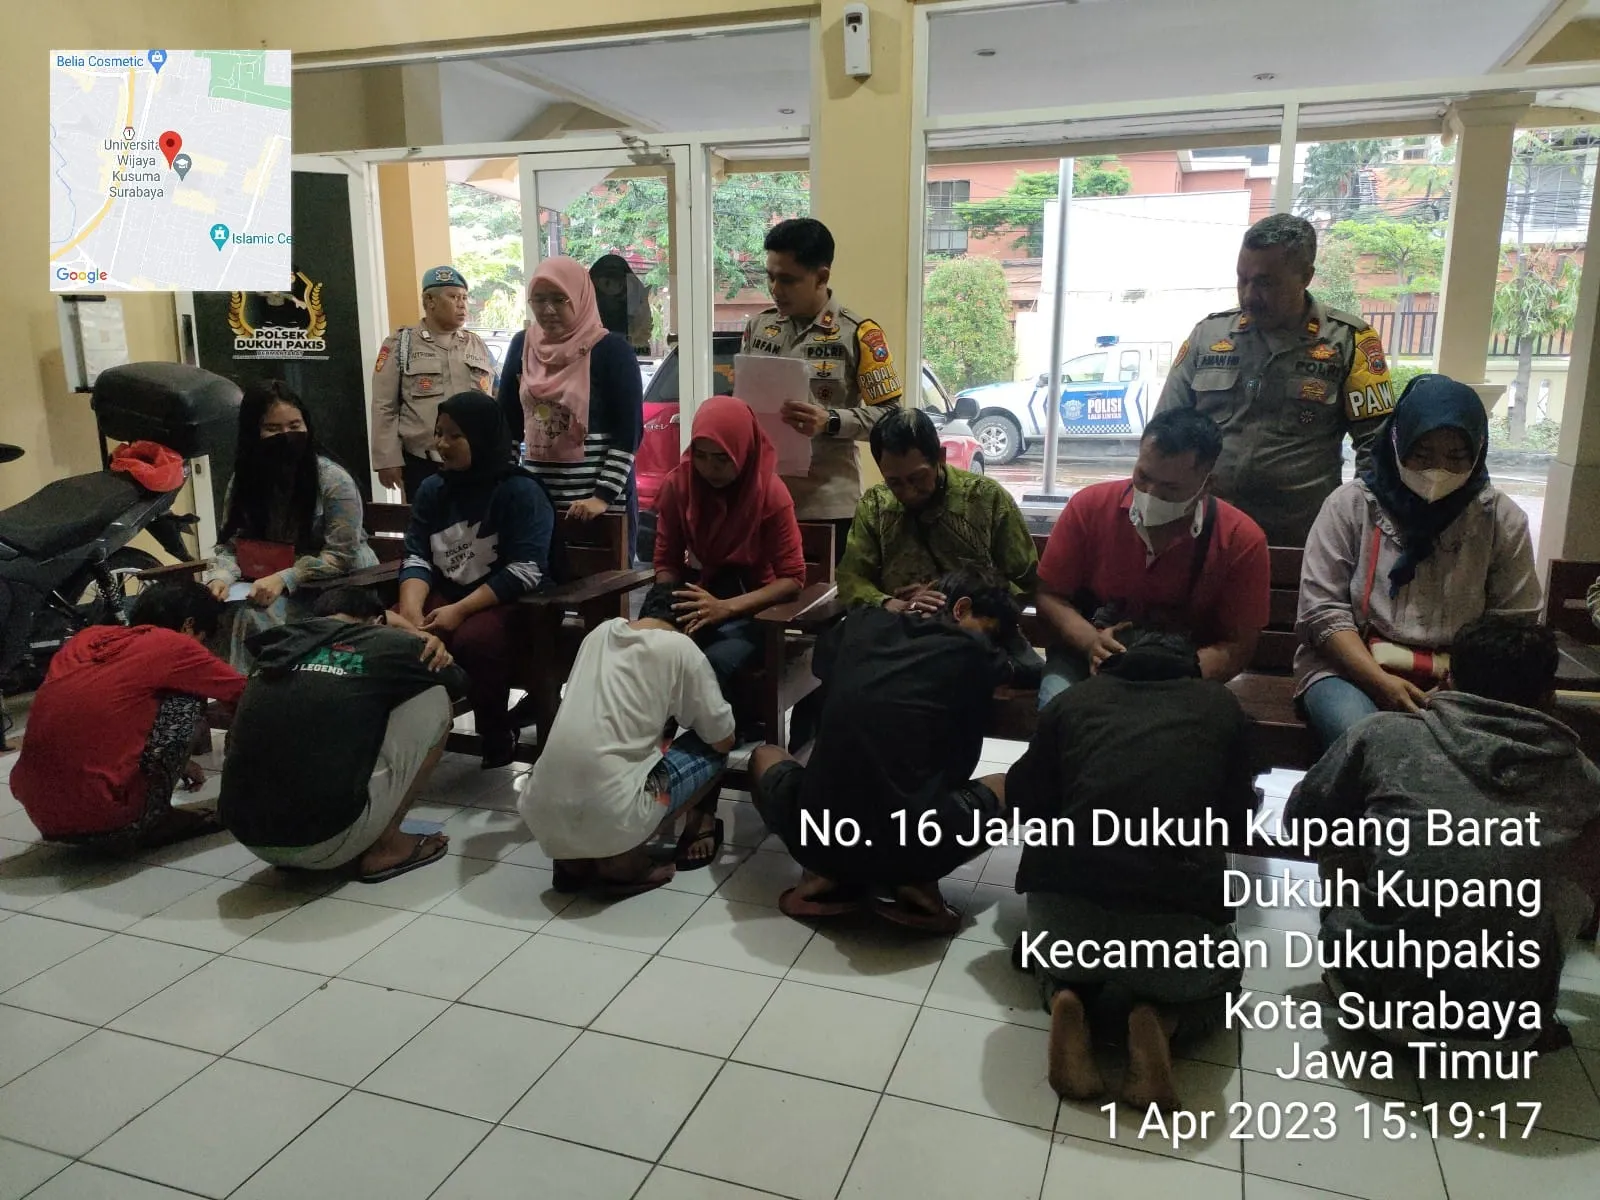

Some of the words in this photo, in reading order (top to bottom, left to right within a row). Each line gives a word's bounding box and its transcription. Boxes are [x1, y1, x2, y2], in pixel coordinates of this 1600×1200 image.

[255, 330, 306, 340] POLSEK
[236, 340, 283, 349] DUKUH
[286, 340, 325, 350] PAKIS
[752, 338, 781, 355] IRFAN
[807, 346, 843, 358] POLRI
[1087, 397, 1122, 414] POLISI
